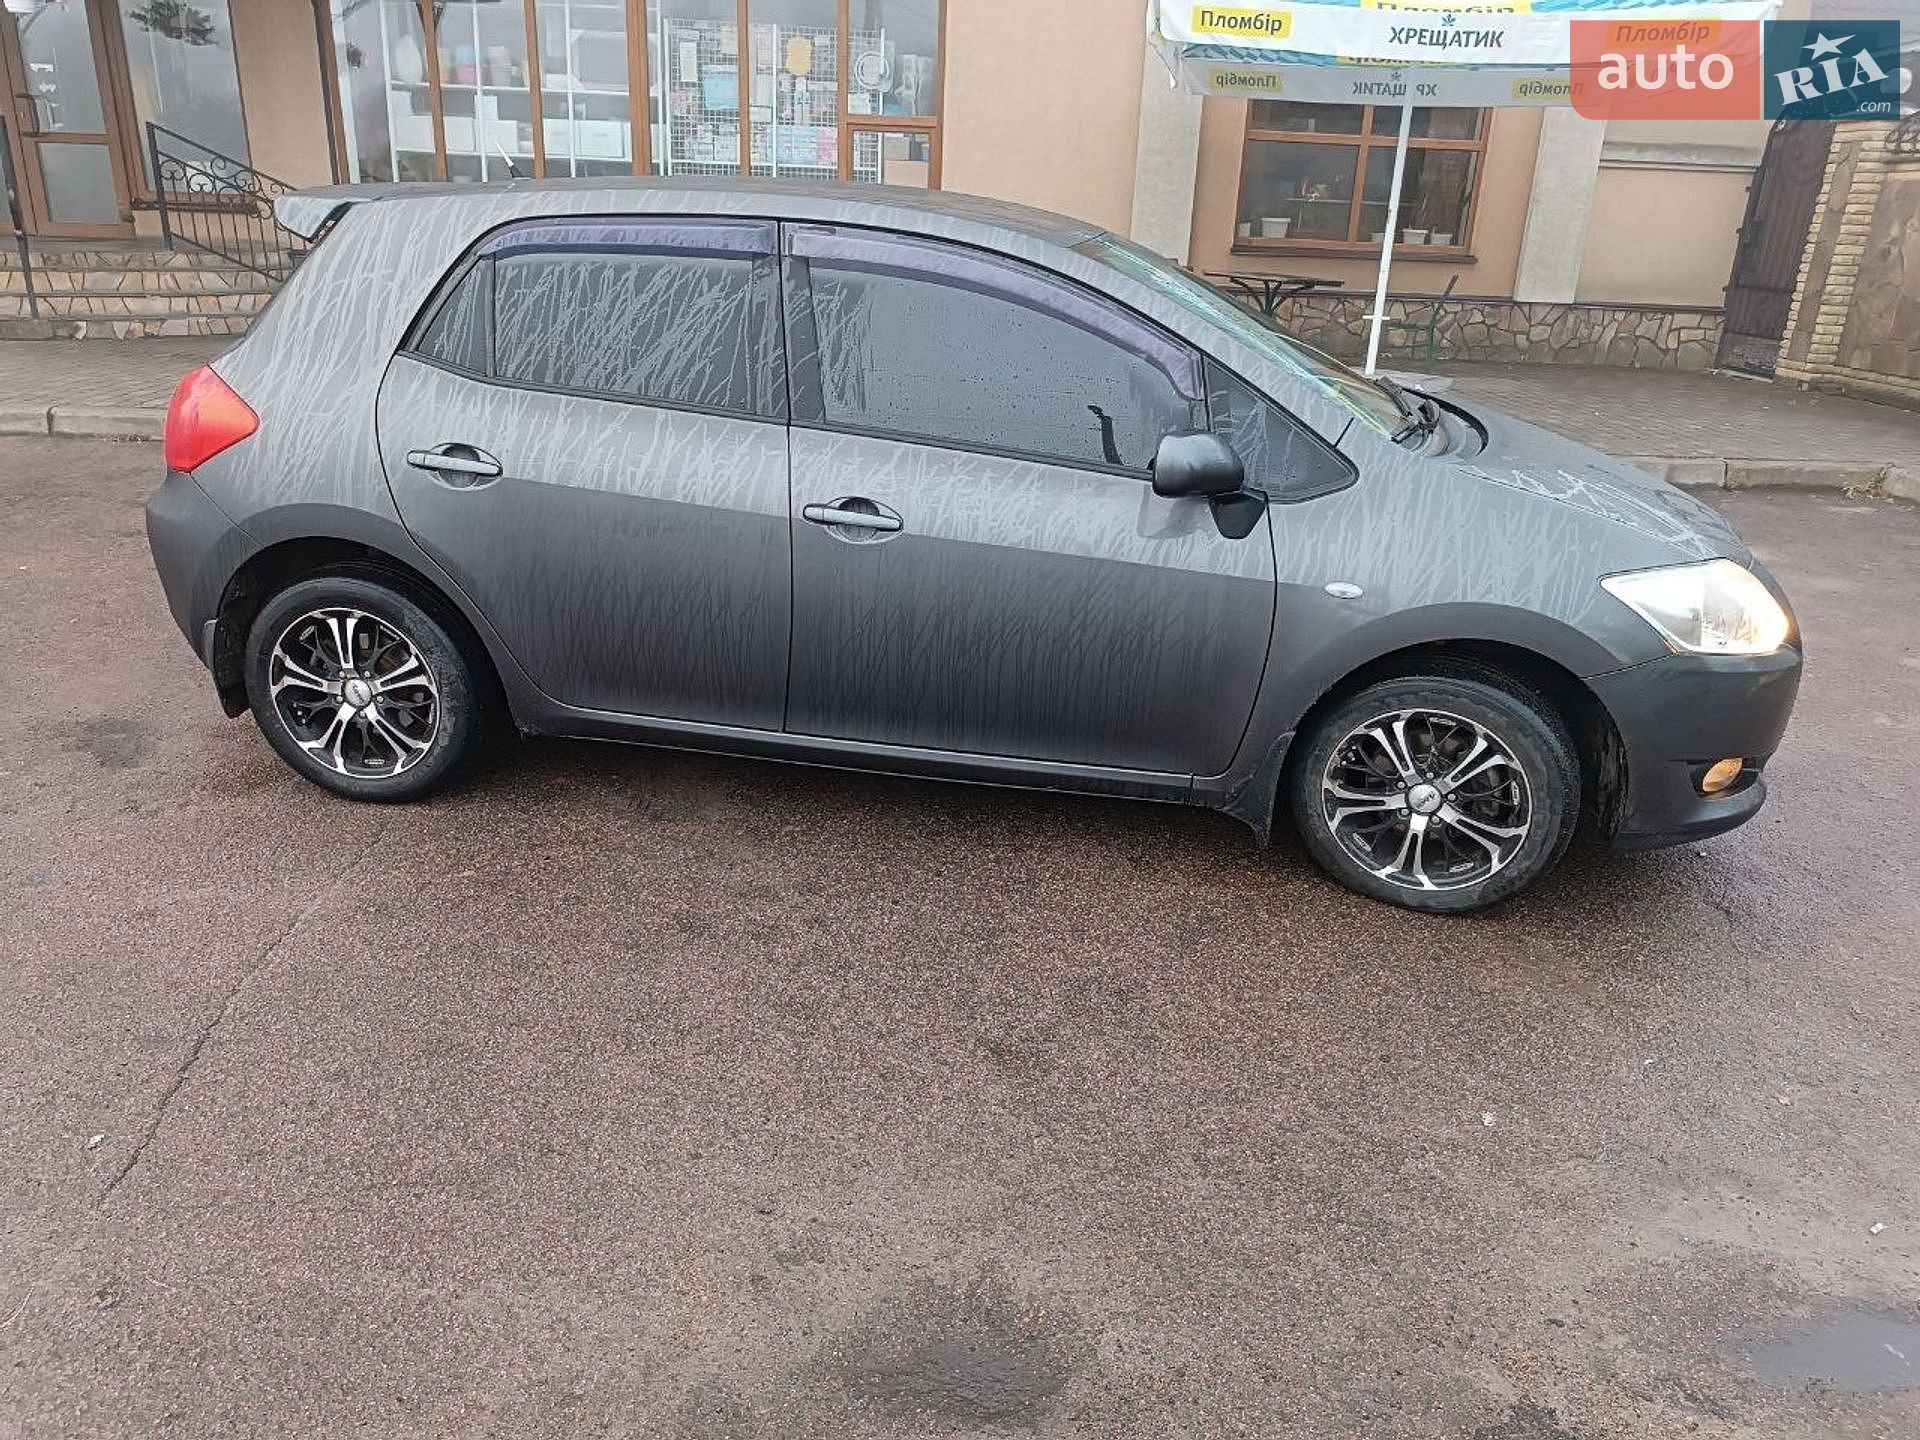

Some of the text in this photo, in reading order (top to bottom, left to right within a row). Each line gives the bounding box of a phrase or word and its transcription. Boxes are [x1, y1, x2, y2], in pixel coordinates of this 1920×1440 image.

[1200, 10, 1283, 35] Пломбір
[1616, 21, 1711, 44] Пломбір
[1389, 26, 1505, 50] ХРЕЩАТИК
